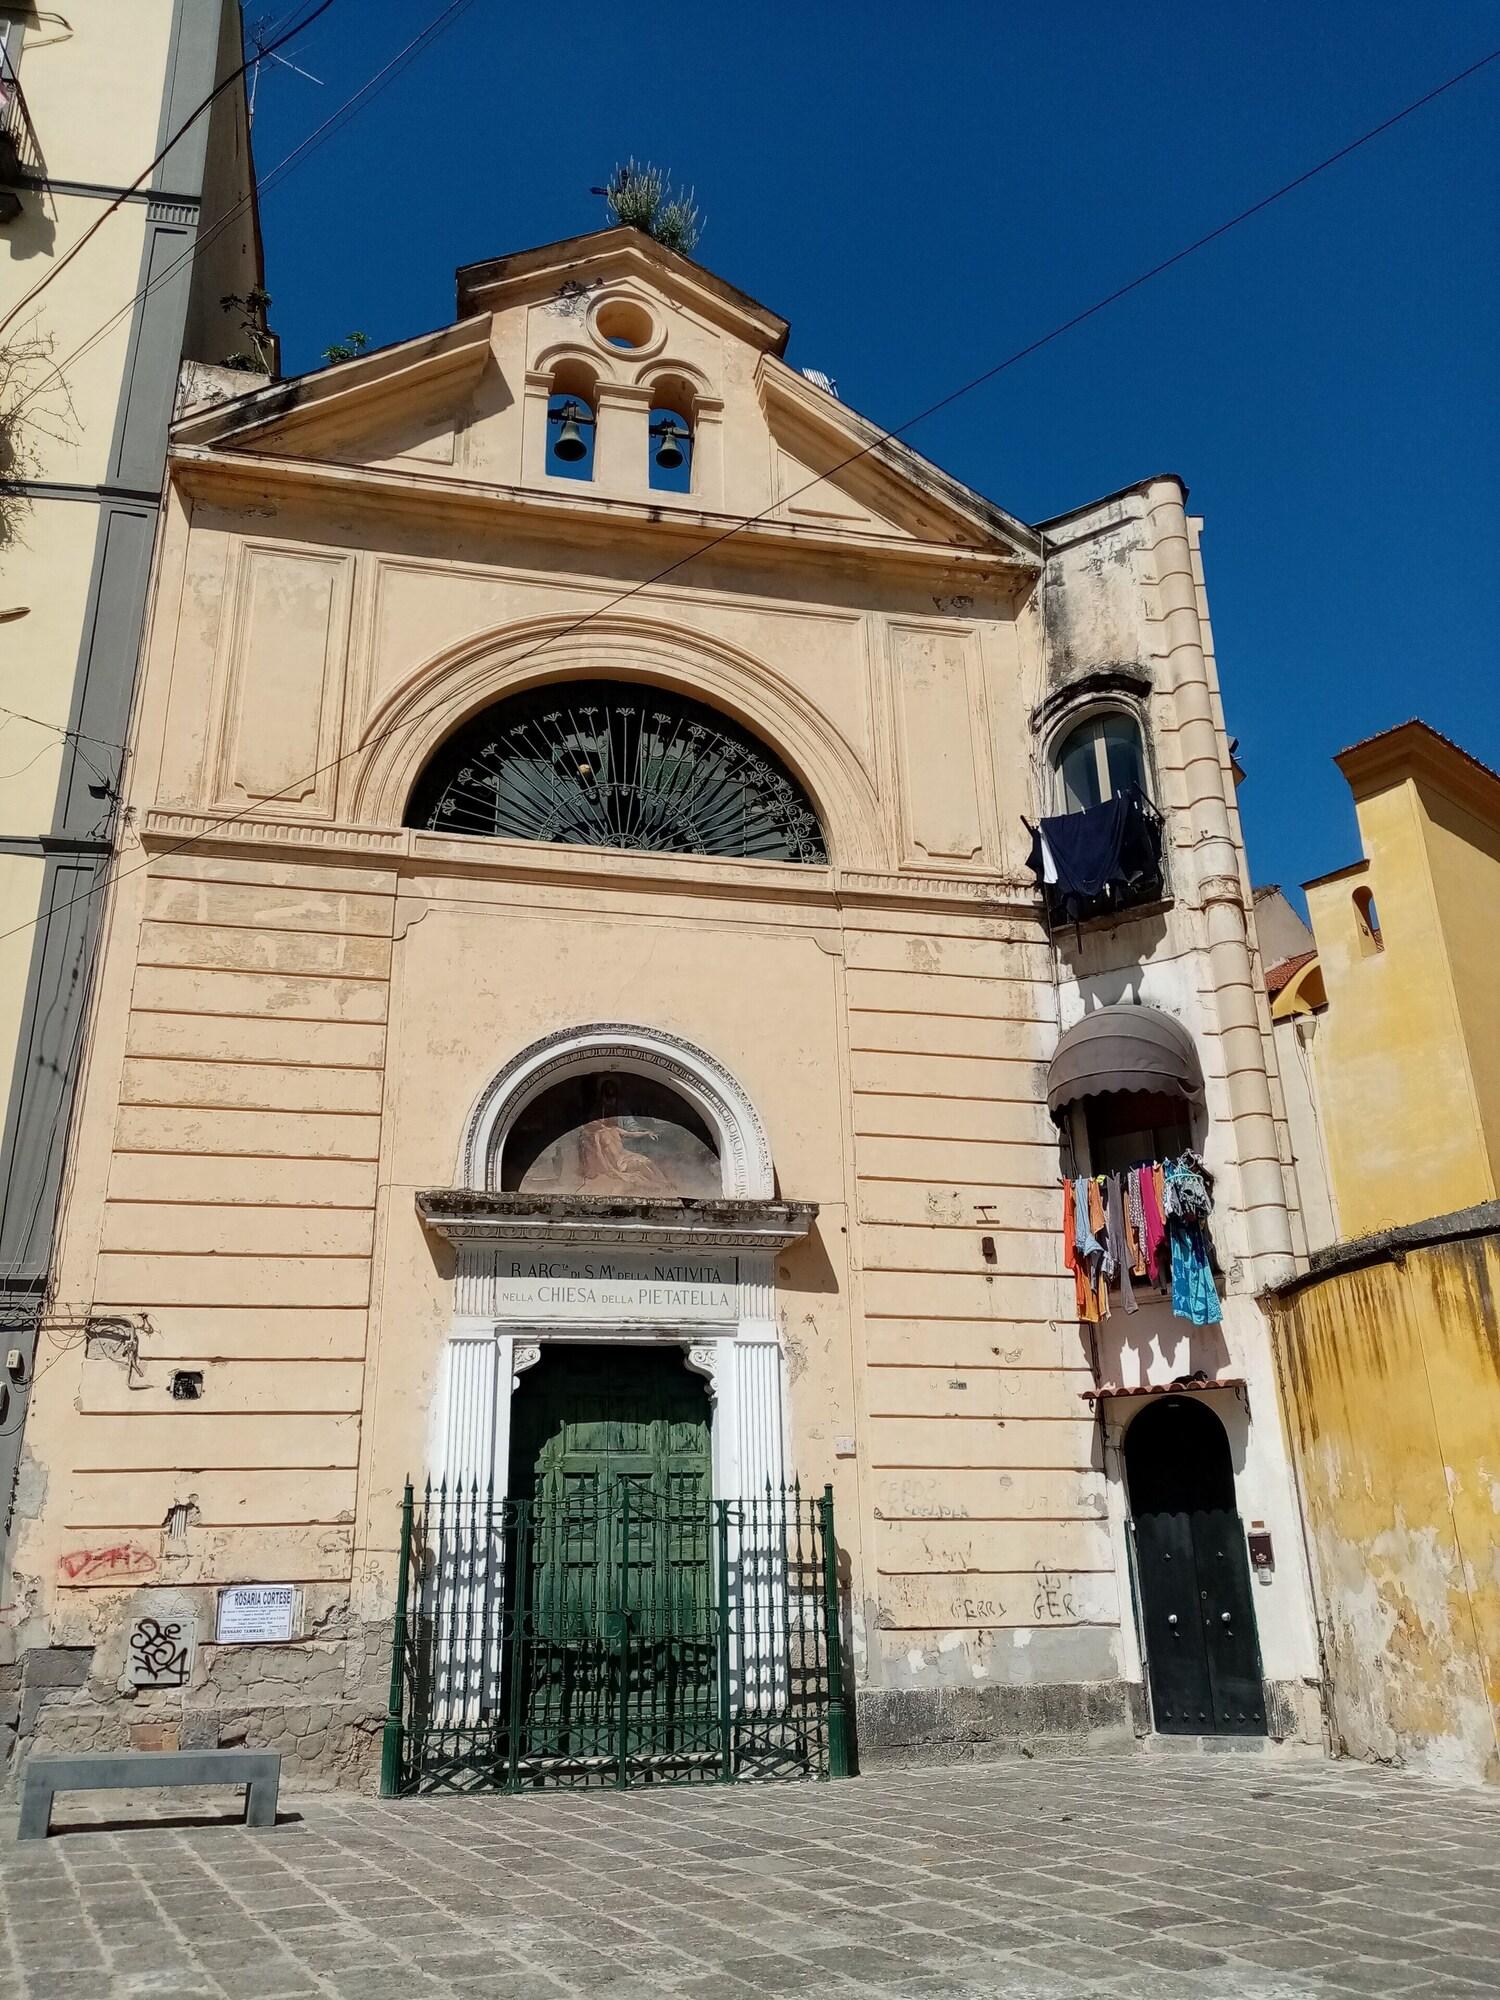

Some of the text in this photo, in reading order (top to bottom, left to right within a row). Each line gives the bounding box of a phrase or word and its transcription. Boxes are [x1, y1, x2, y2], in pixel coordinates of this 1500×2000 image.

[570, 1271, 580, 1279] DI
[617, 1271, 649, 1281] DELLA
[502, 1286, 729, 1306] NELLA CHIESA DELLA PIETATELLA
[235, 1591, 290, 1606] ROSARIA CORTESE
